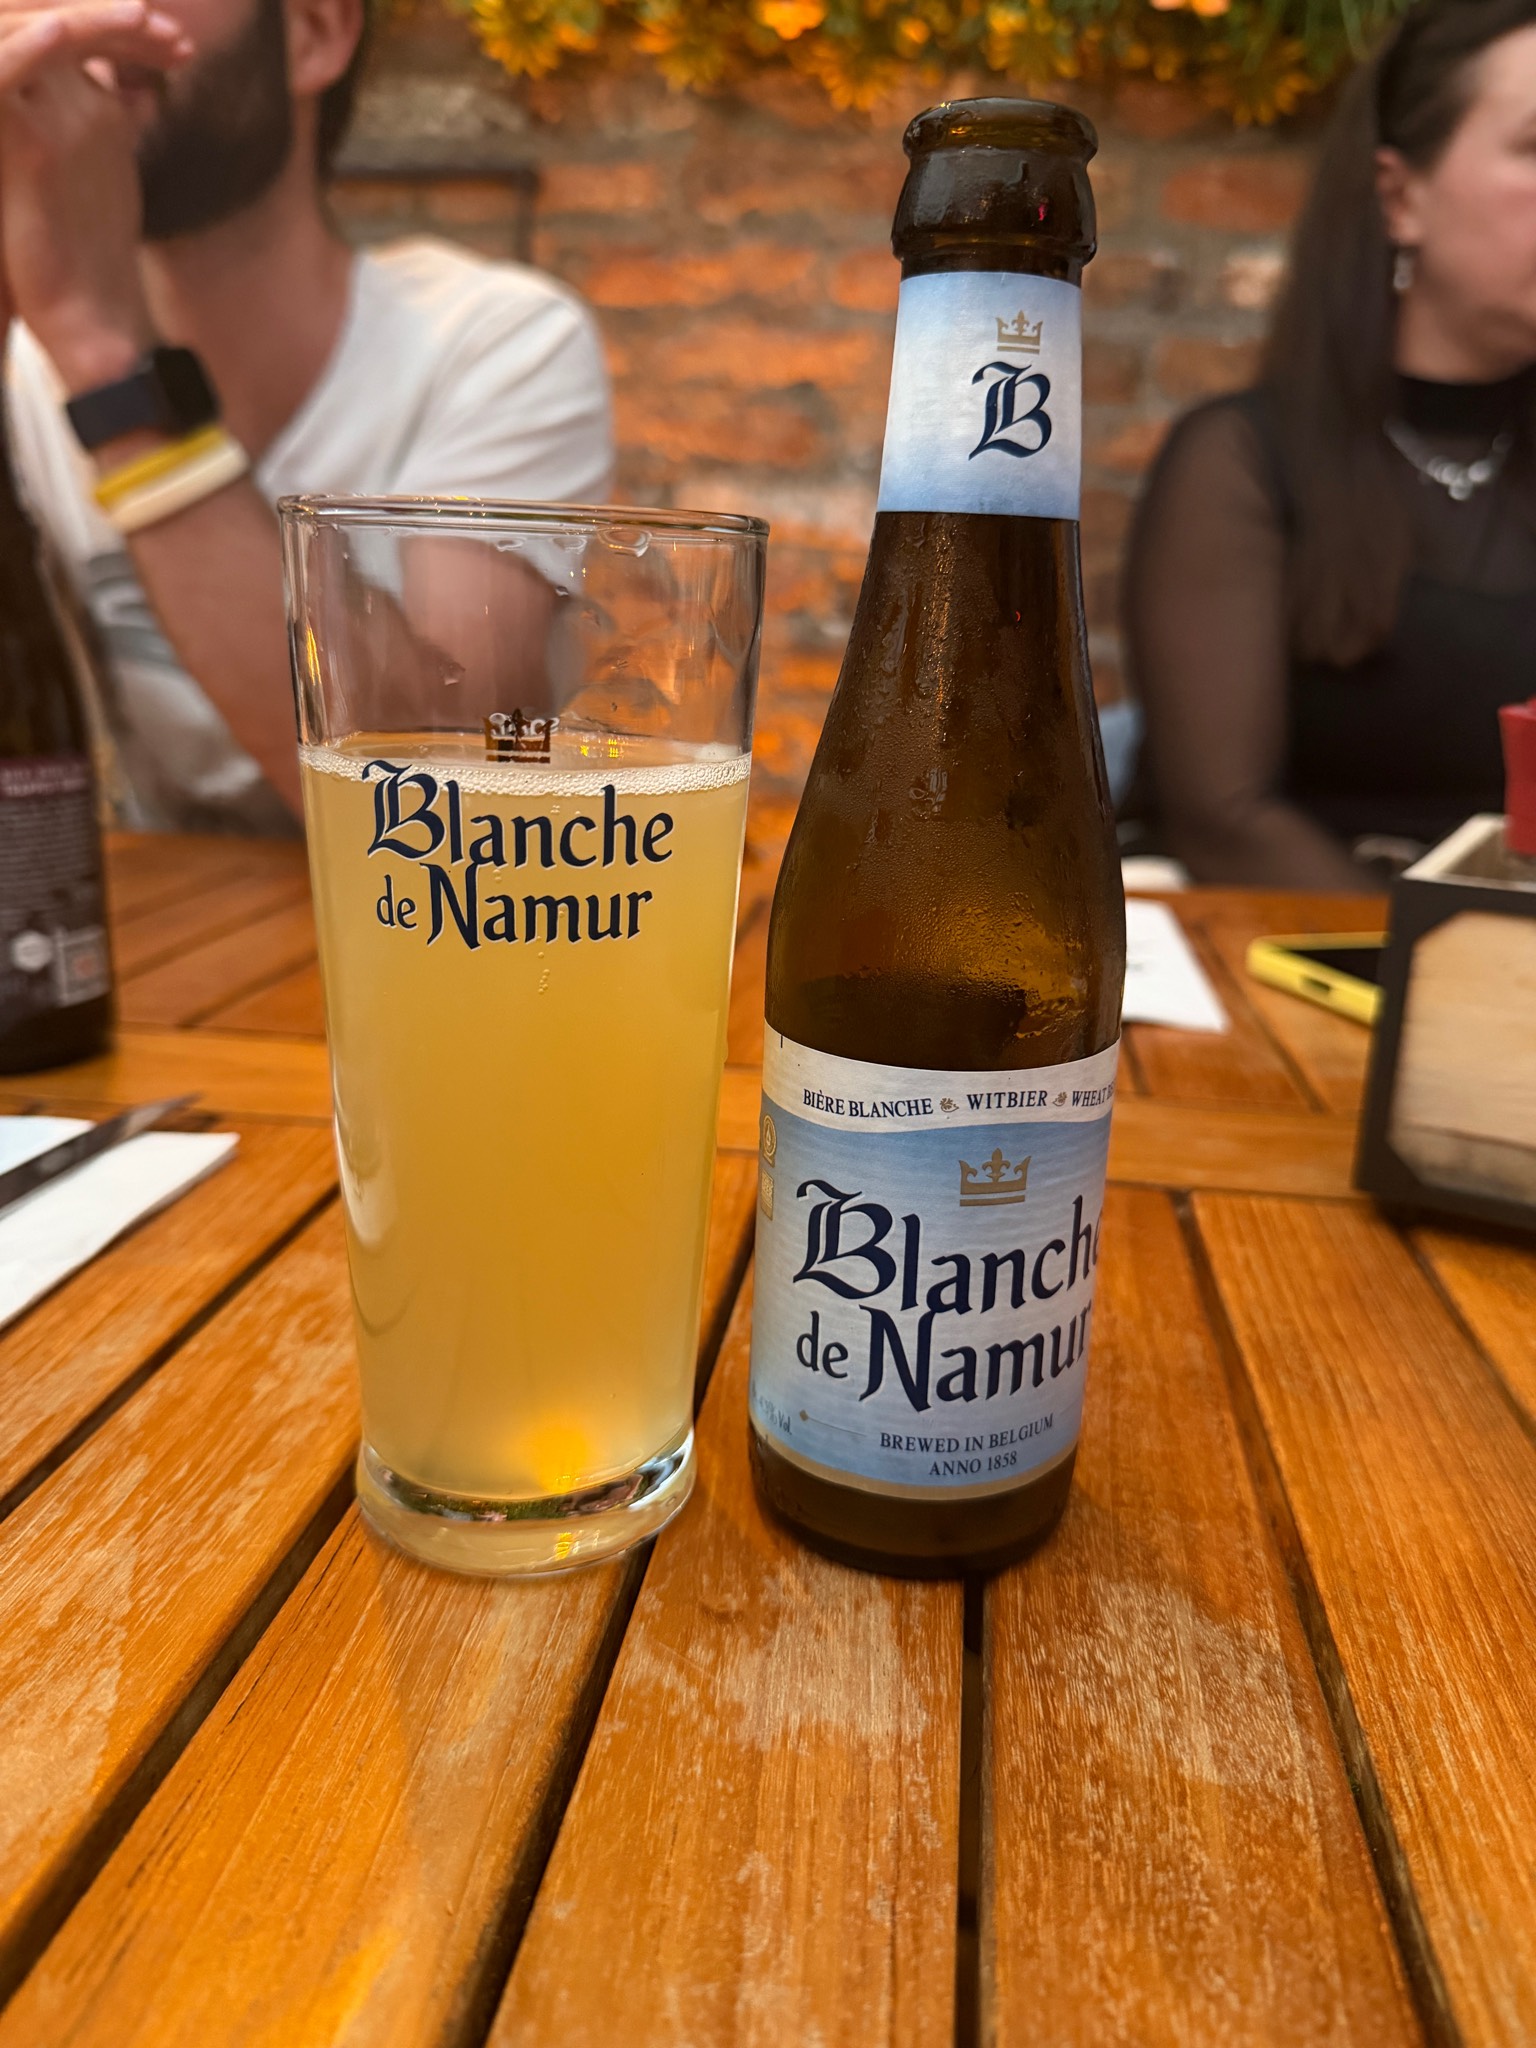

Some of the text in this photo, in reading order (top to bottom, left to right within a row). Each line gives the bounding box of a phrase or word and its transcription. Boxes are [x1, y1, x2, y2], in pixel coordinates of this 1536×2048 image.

[969, 361, 1052, 461] B
[362, 760, 675, 869] Blanche
[376, 861, 653, 950] de Namur
[803, 1089, 846, 1116] BIÈRE
[848, 1098, 934, 1118] BLANCHE
[966, 1090, 1049, 1112] WITBIER
[1072, 1086, 1107, 1107] WHEAT
[796, 1310, 849, 1378] de
[880, 1413, 1054, 1453] BREWED IN BELGIUM
[929, 1451, 1018, 1476] ANNO 1858
